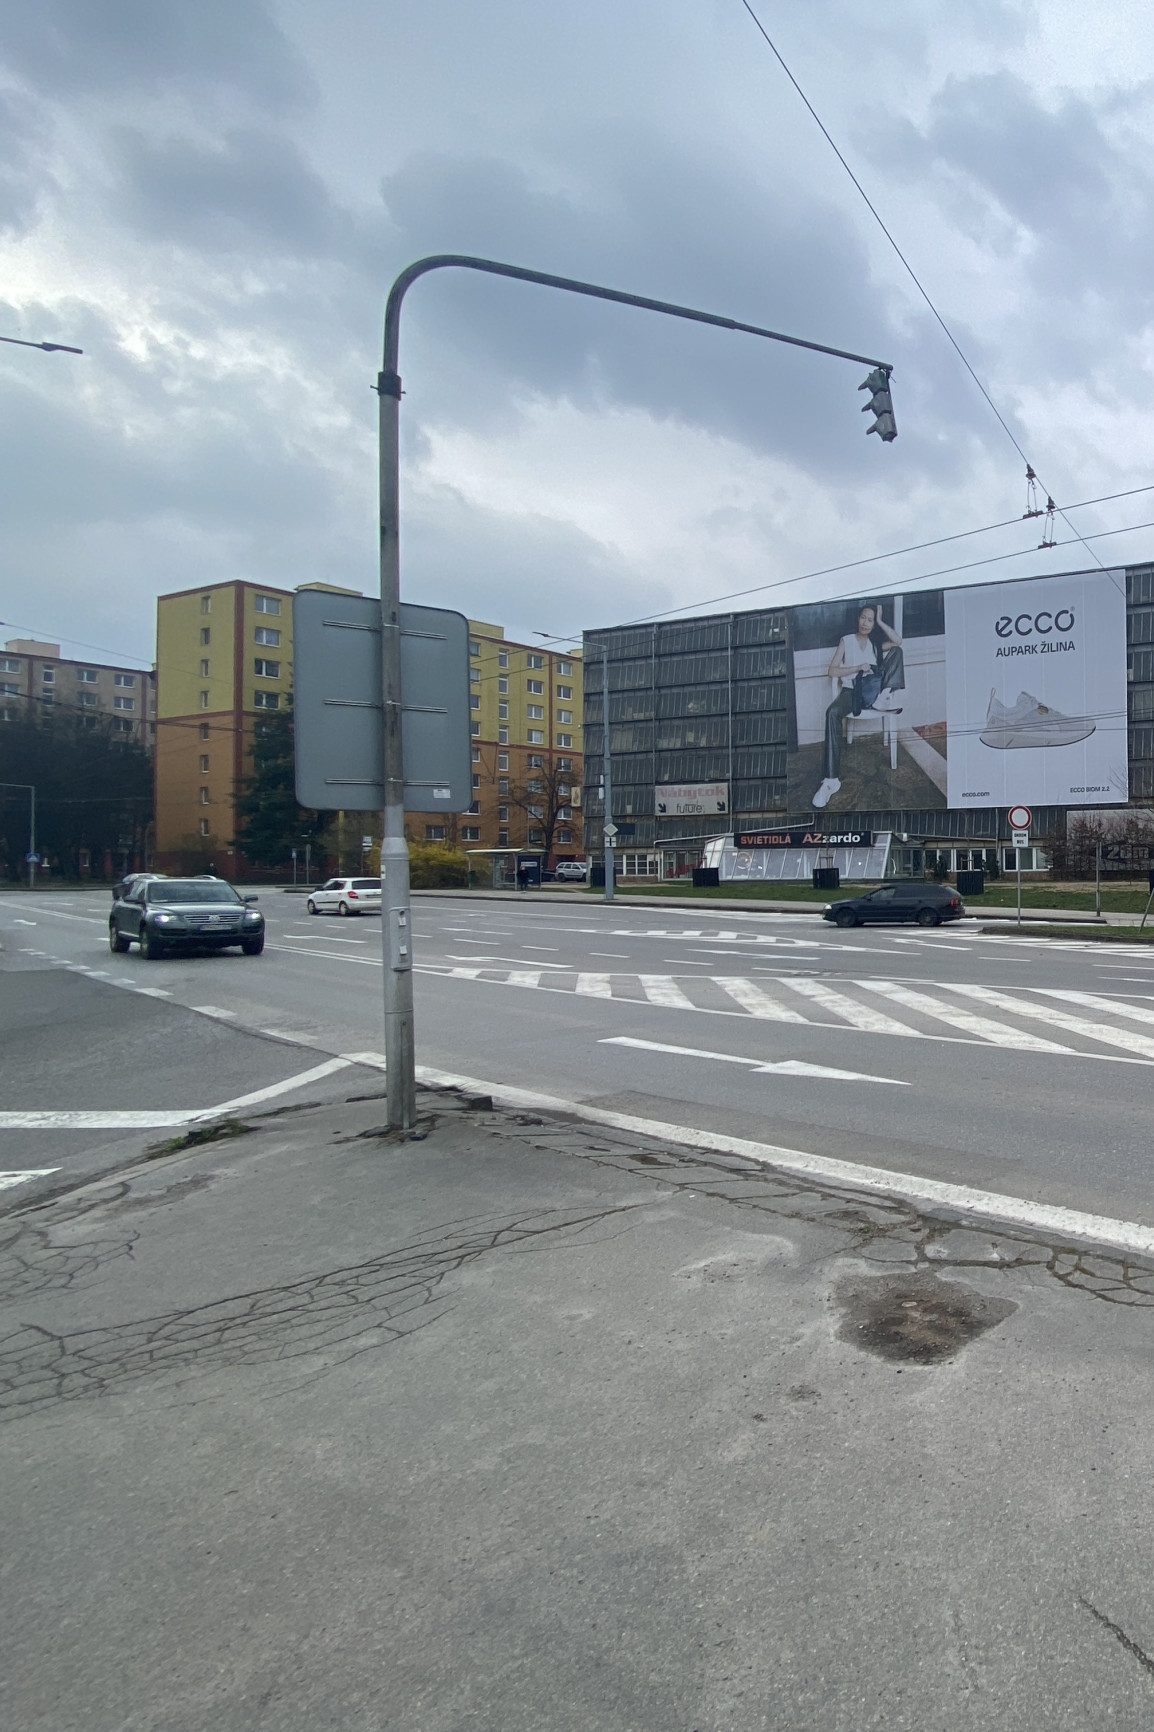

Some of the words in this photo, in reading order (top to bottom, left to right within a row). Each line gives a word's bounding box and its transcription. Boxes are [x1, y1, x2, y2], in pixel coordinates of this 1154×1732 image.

[995, 609, 1075, 638] ecco
[995, 644, 1038, 658] AUPARK
[1040, 640, 1076, 654] ŽILINA
[740, 833, 792, 845] SVIETIDLÁ
[802, 832, 861, 844] AZzardo
